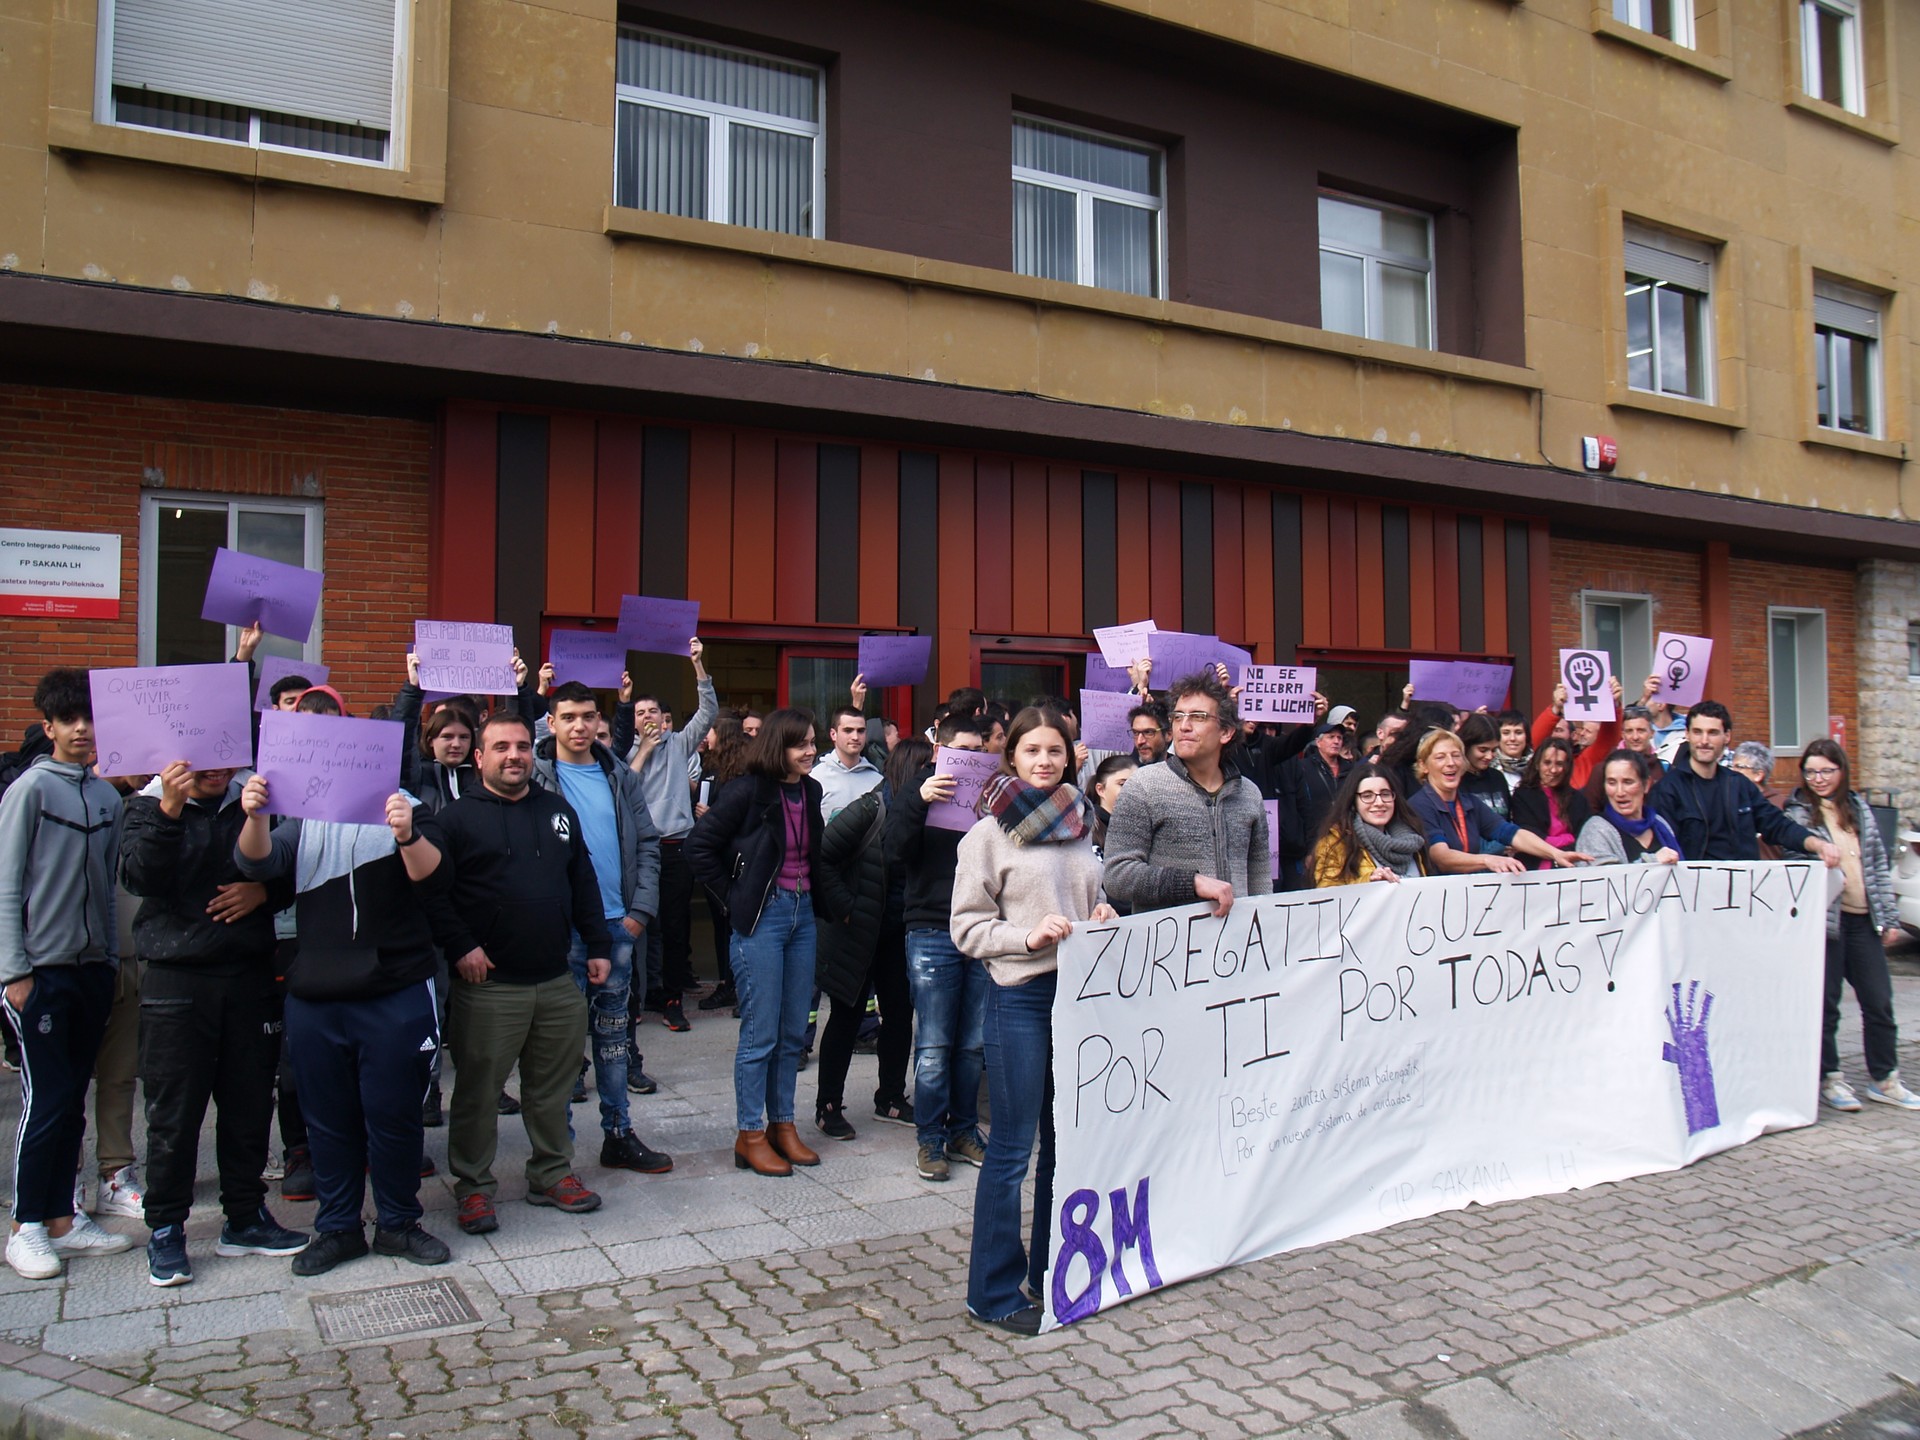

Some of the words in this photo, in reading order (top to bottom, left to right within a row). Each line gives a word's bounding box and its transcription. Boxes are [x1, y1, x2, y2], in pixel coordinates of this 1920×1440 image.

[1, 540, 25, 548] Centro
[26, 541, 60, 550] Integrado
[62, 543, 100, 552] Politécnico
[19, 559, 31, 567] FP
[32, 560, 68, 568] SAKANA
[70, 561, 81, 569] LH
[28, 579, 60, 588] Integratu
[61, 580, 105, 588] Politeknikoa
[418, 623, 438, 640] EL
[431, 647, 450, 661] ME
[460, 649, 476, 662] DA
[1156, 637, 1186, 657] 365
[1246, 667, 1264, 680] NO
[1279, 668, 1297, 680] SE
[108, 677, 181, 694] QUEREMOS
[1246, 682, 1304, 694] CELEBRA
[134, 691, 172, 705] VIVIR
[1244, 698, 1263, 712] SE
[1272, 699, 1315, 713] LUCHA
[148, 704, 190, 716] LIBRES
[264, 720, 331, 748] Luchemos
[336, 741, 358, 757] por
[366, 742, 385, 753] una
[1075, 897, 1363, 1001] ZUREGATIK
[1075, 1027, 1171, 1129] POR
[1205, 992, 1291, 1079] TI
[1339, 965, 1417, 1042] POR
[1230, 1092, 1280, 1128] Beste
[1333, 1074, 1371, 1100] sistema
[1236, 1136, 1257, 1164] Por
[1281, 1127, 1312, 1146] nuevo
[1318, 1113, 1353, 1134] sistema
[1357, 1103, 1368, 1118] de
[1050, 1174, 1165, 1326] 8M
